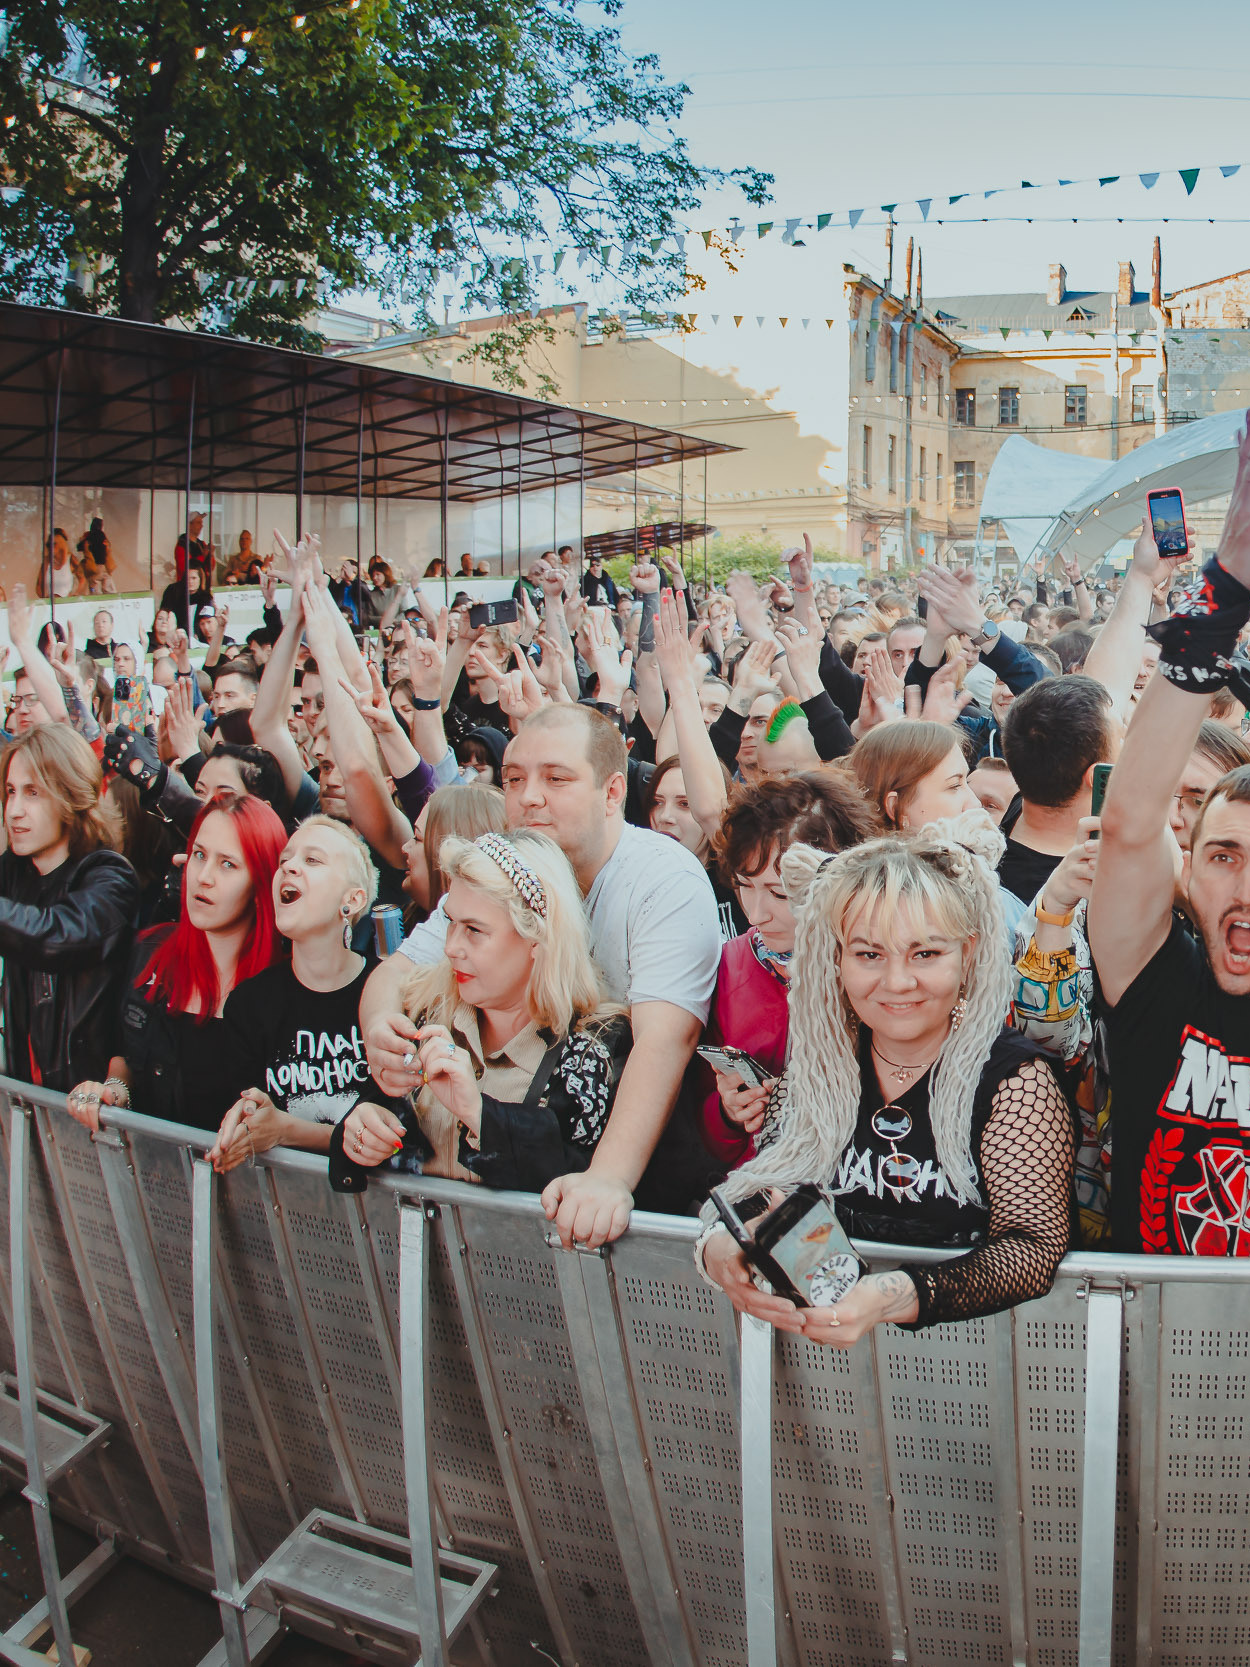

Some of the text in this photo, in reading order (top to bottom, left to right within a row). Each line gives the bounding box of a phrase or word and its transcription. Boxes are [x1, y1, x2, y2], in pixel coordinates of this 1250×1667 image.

[296, 1025, 365, 1060] ПЛАН
[265, 1058, 372, 1097] ЛОМОНОС
[830, 1273, 857, 1304] БОБРЫ
